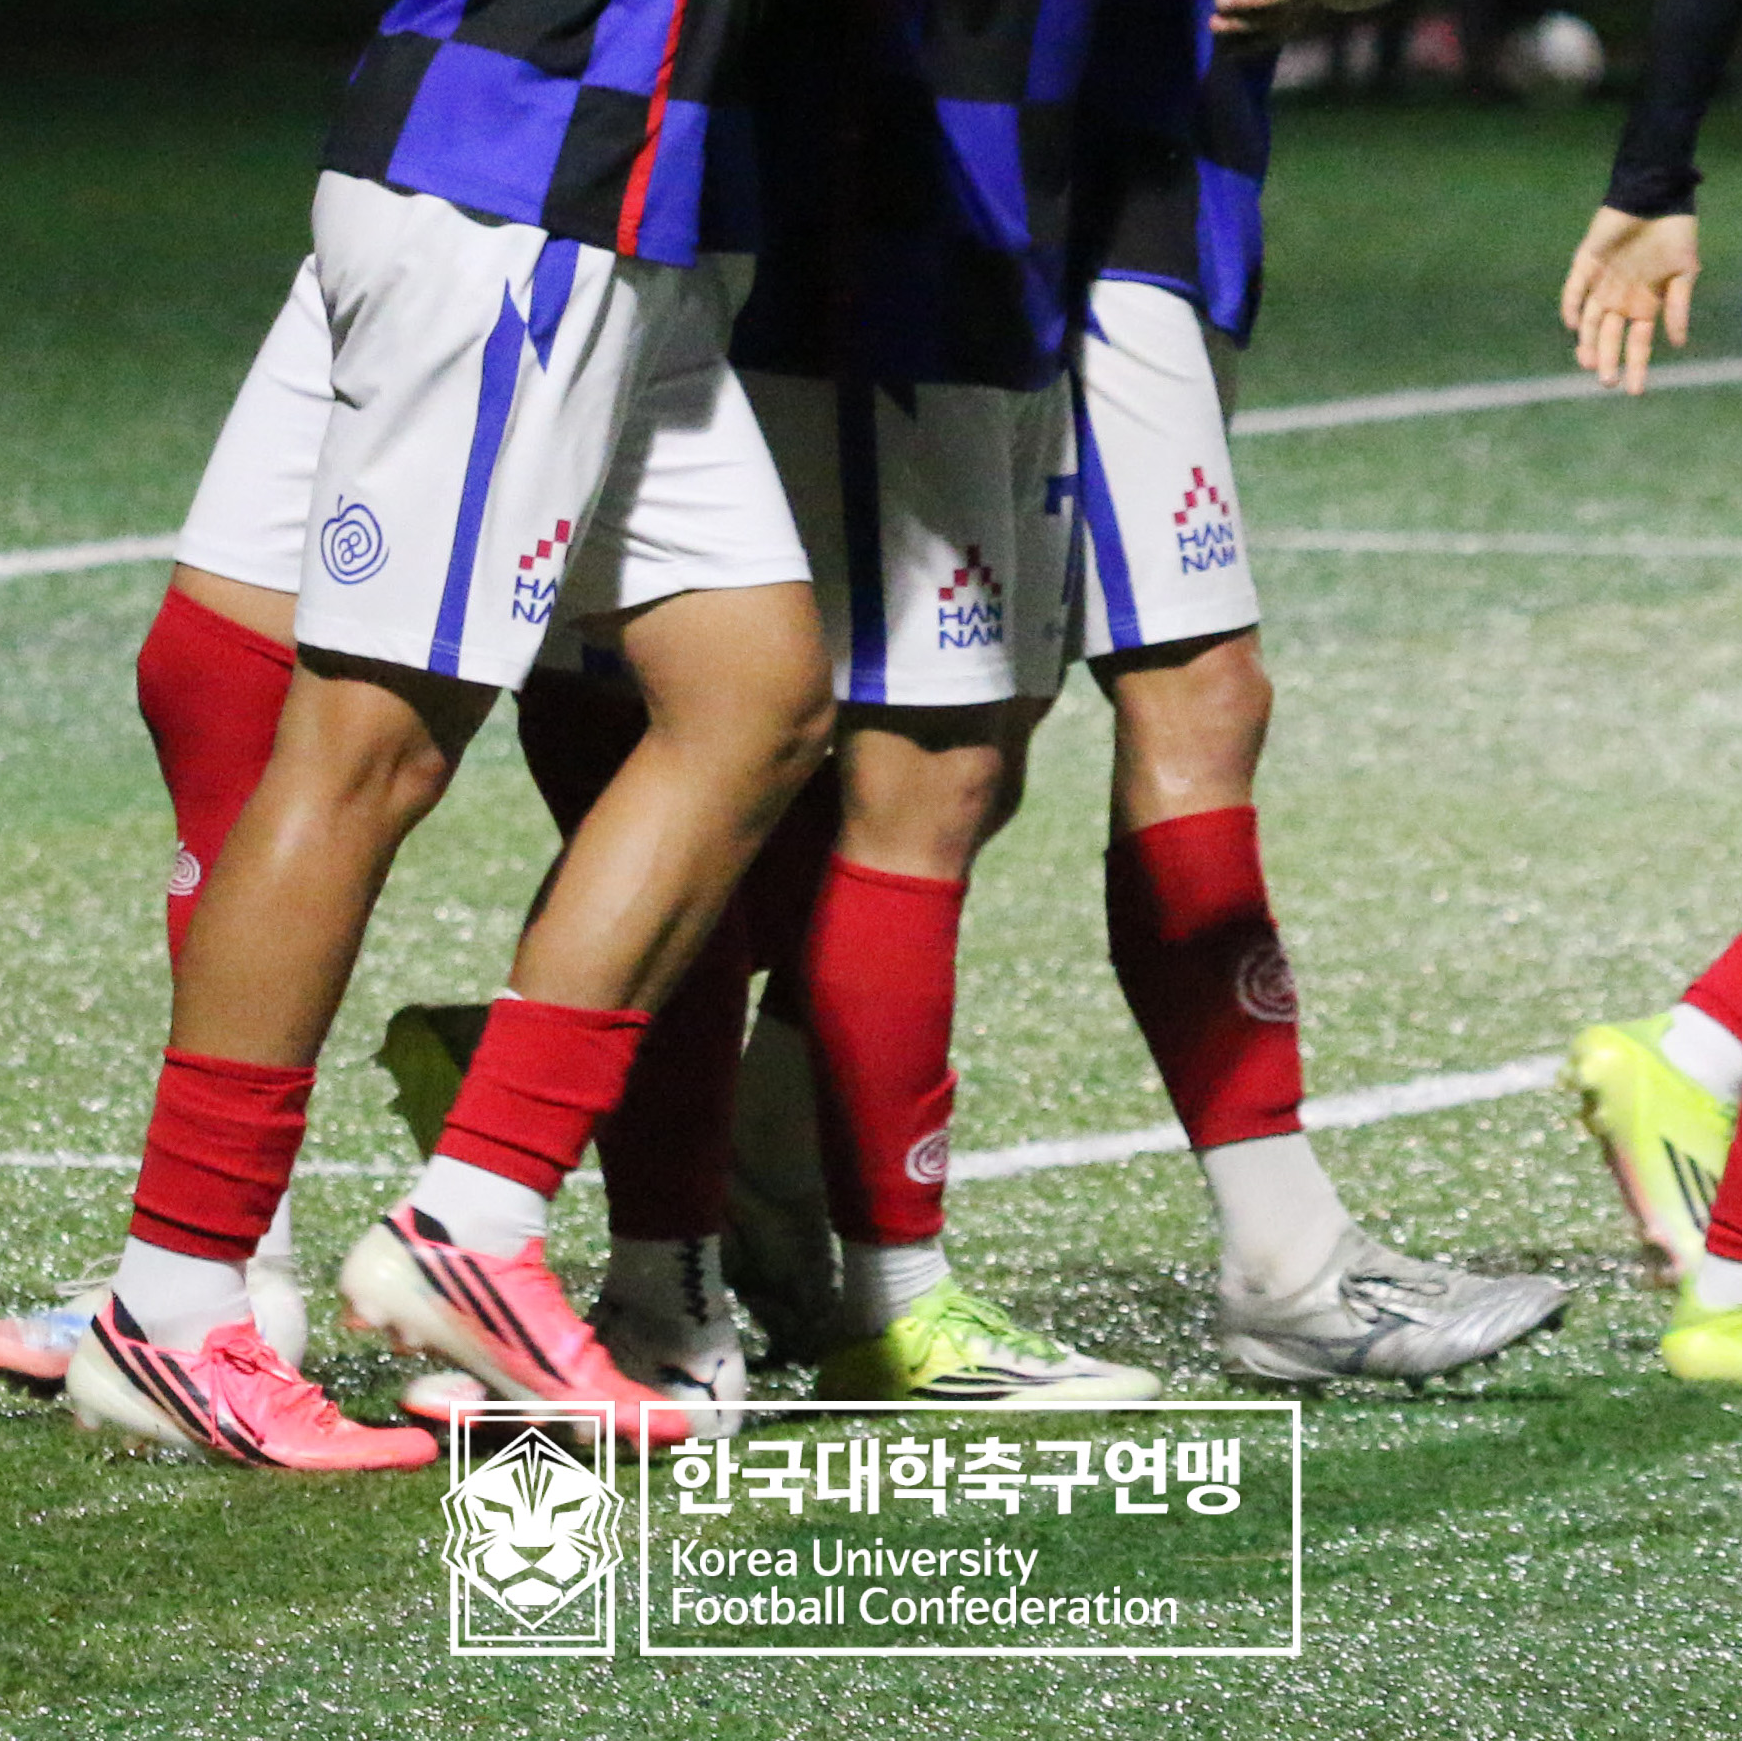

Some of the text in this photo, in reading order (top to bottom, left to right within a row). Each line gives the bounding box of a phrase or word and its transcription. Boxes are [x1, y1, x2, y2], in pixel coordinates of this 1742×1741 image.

[1175, 520, 1235, 552] HAN
[1180, 544, 1238, 576] NAM
[937, 600, 1004, 627] HAN
[937, 624, 1004, 650] NAM
